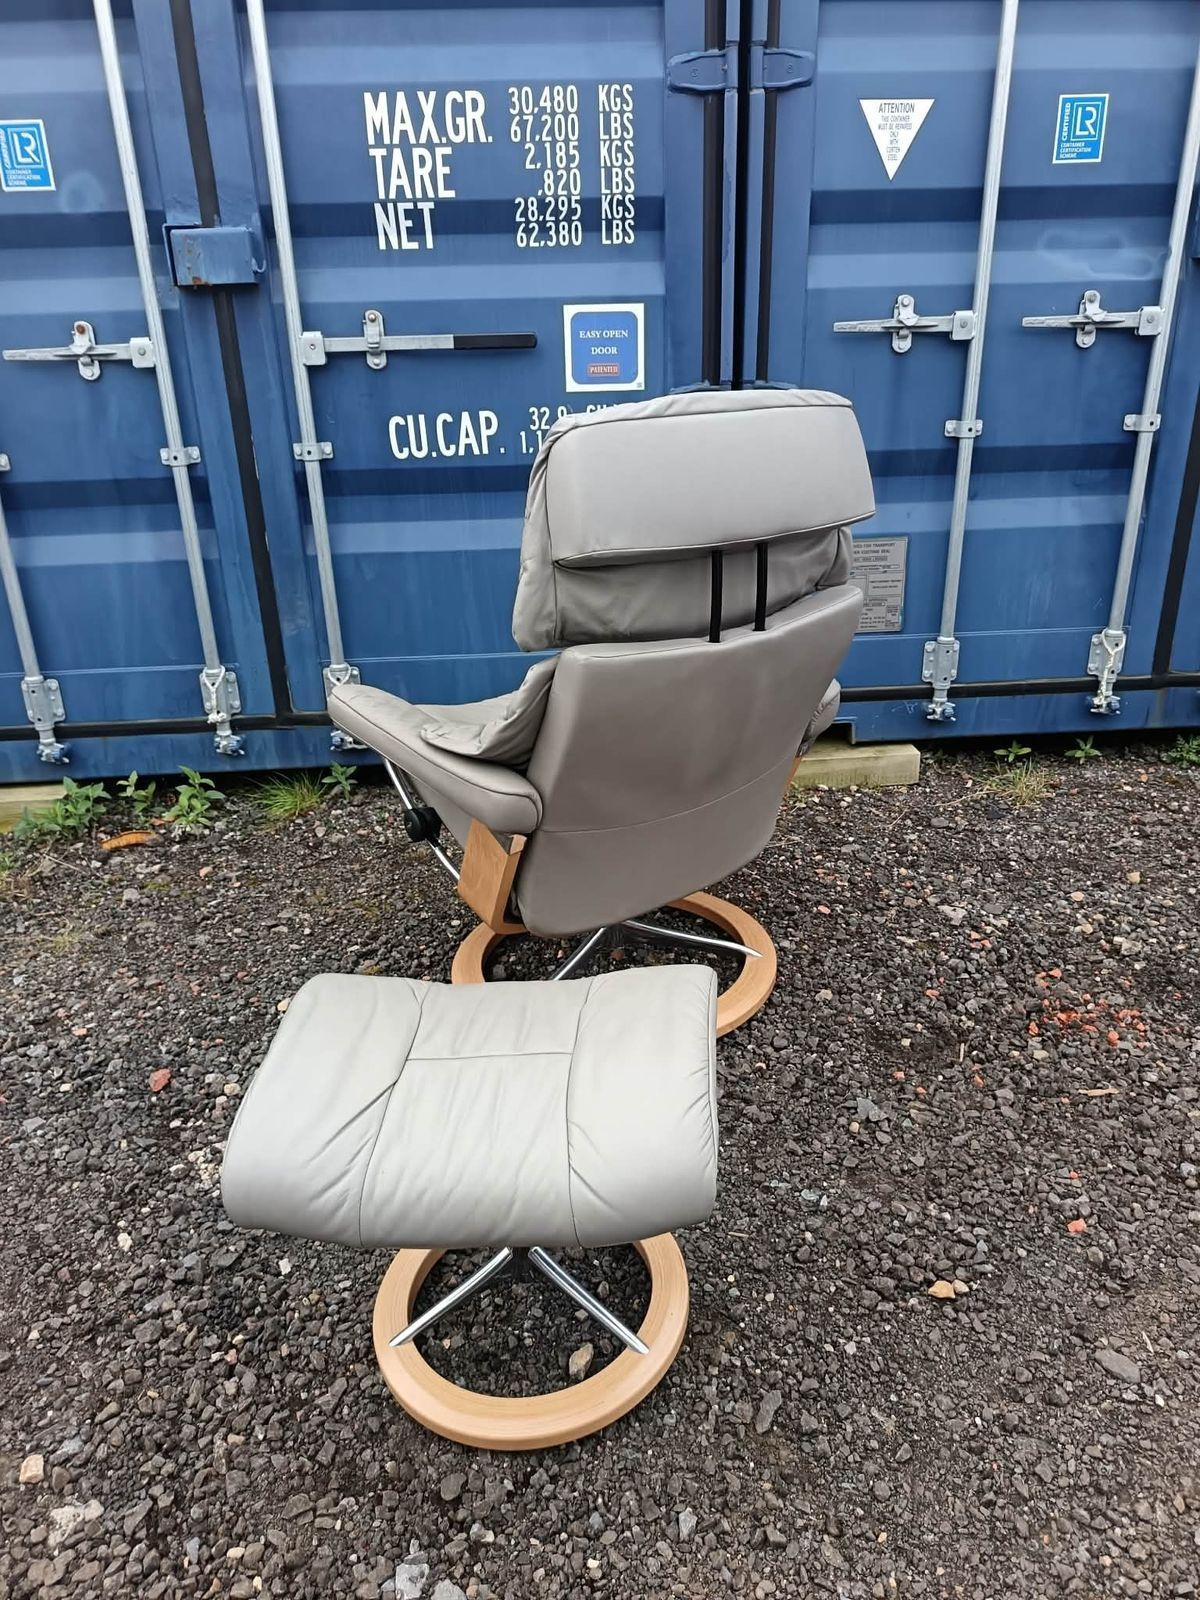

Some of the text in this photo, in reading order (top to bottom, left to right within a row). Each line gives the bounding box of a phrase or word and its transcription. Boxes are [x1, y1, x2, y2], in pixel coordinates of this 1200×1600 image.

[508, 83, 634, 115] 30,480 KGS
[879, 102, 915, 114] ATTENTION
[363, 90, 493, 146] MAX.GR.
[510, 111, 634, 143] 67,200 LBS
[1062, 102, 1071, 141] CERTIFIED
[524, 139, 635, 170] 2,185 KGS
[368, 146, 456, 200] TARE
[600, 166, 635, 194] LBS
[514, 193, 635, 222] 28,295 KGS
[373, 201, 435, 250] NET
[516, 219, 635, 248] 62,380 LBS
[579, 329, 629, 339] EASY OPEN
[591, 346, 618, 355] DOOR
[589, 365, 618, 374] PATENTED
